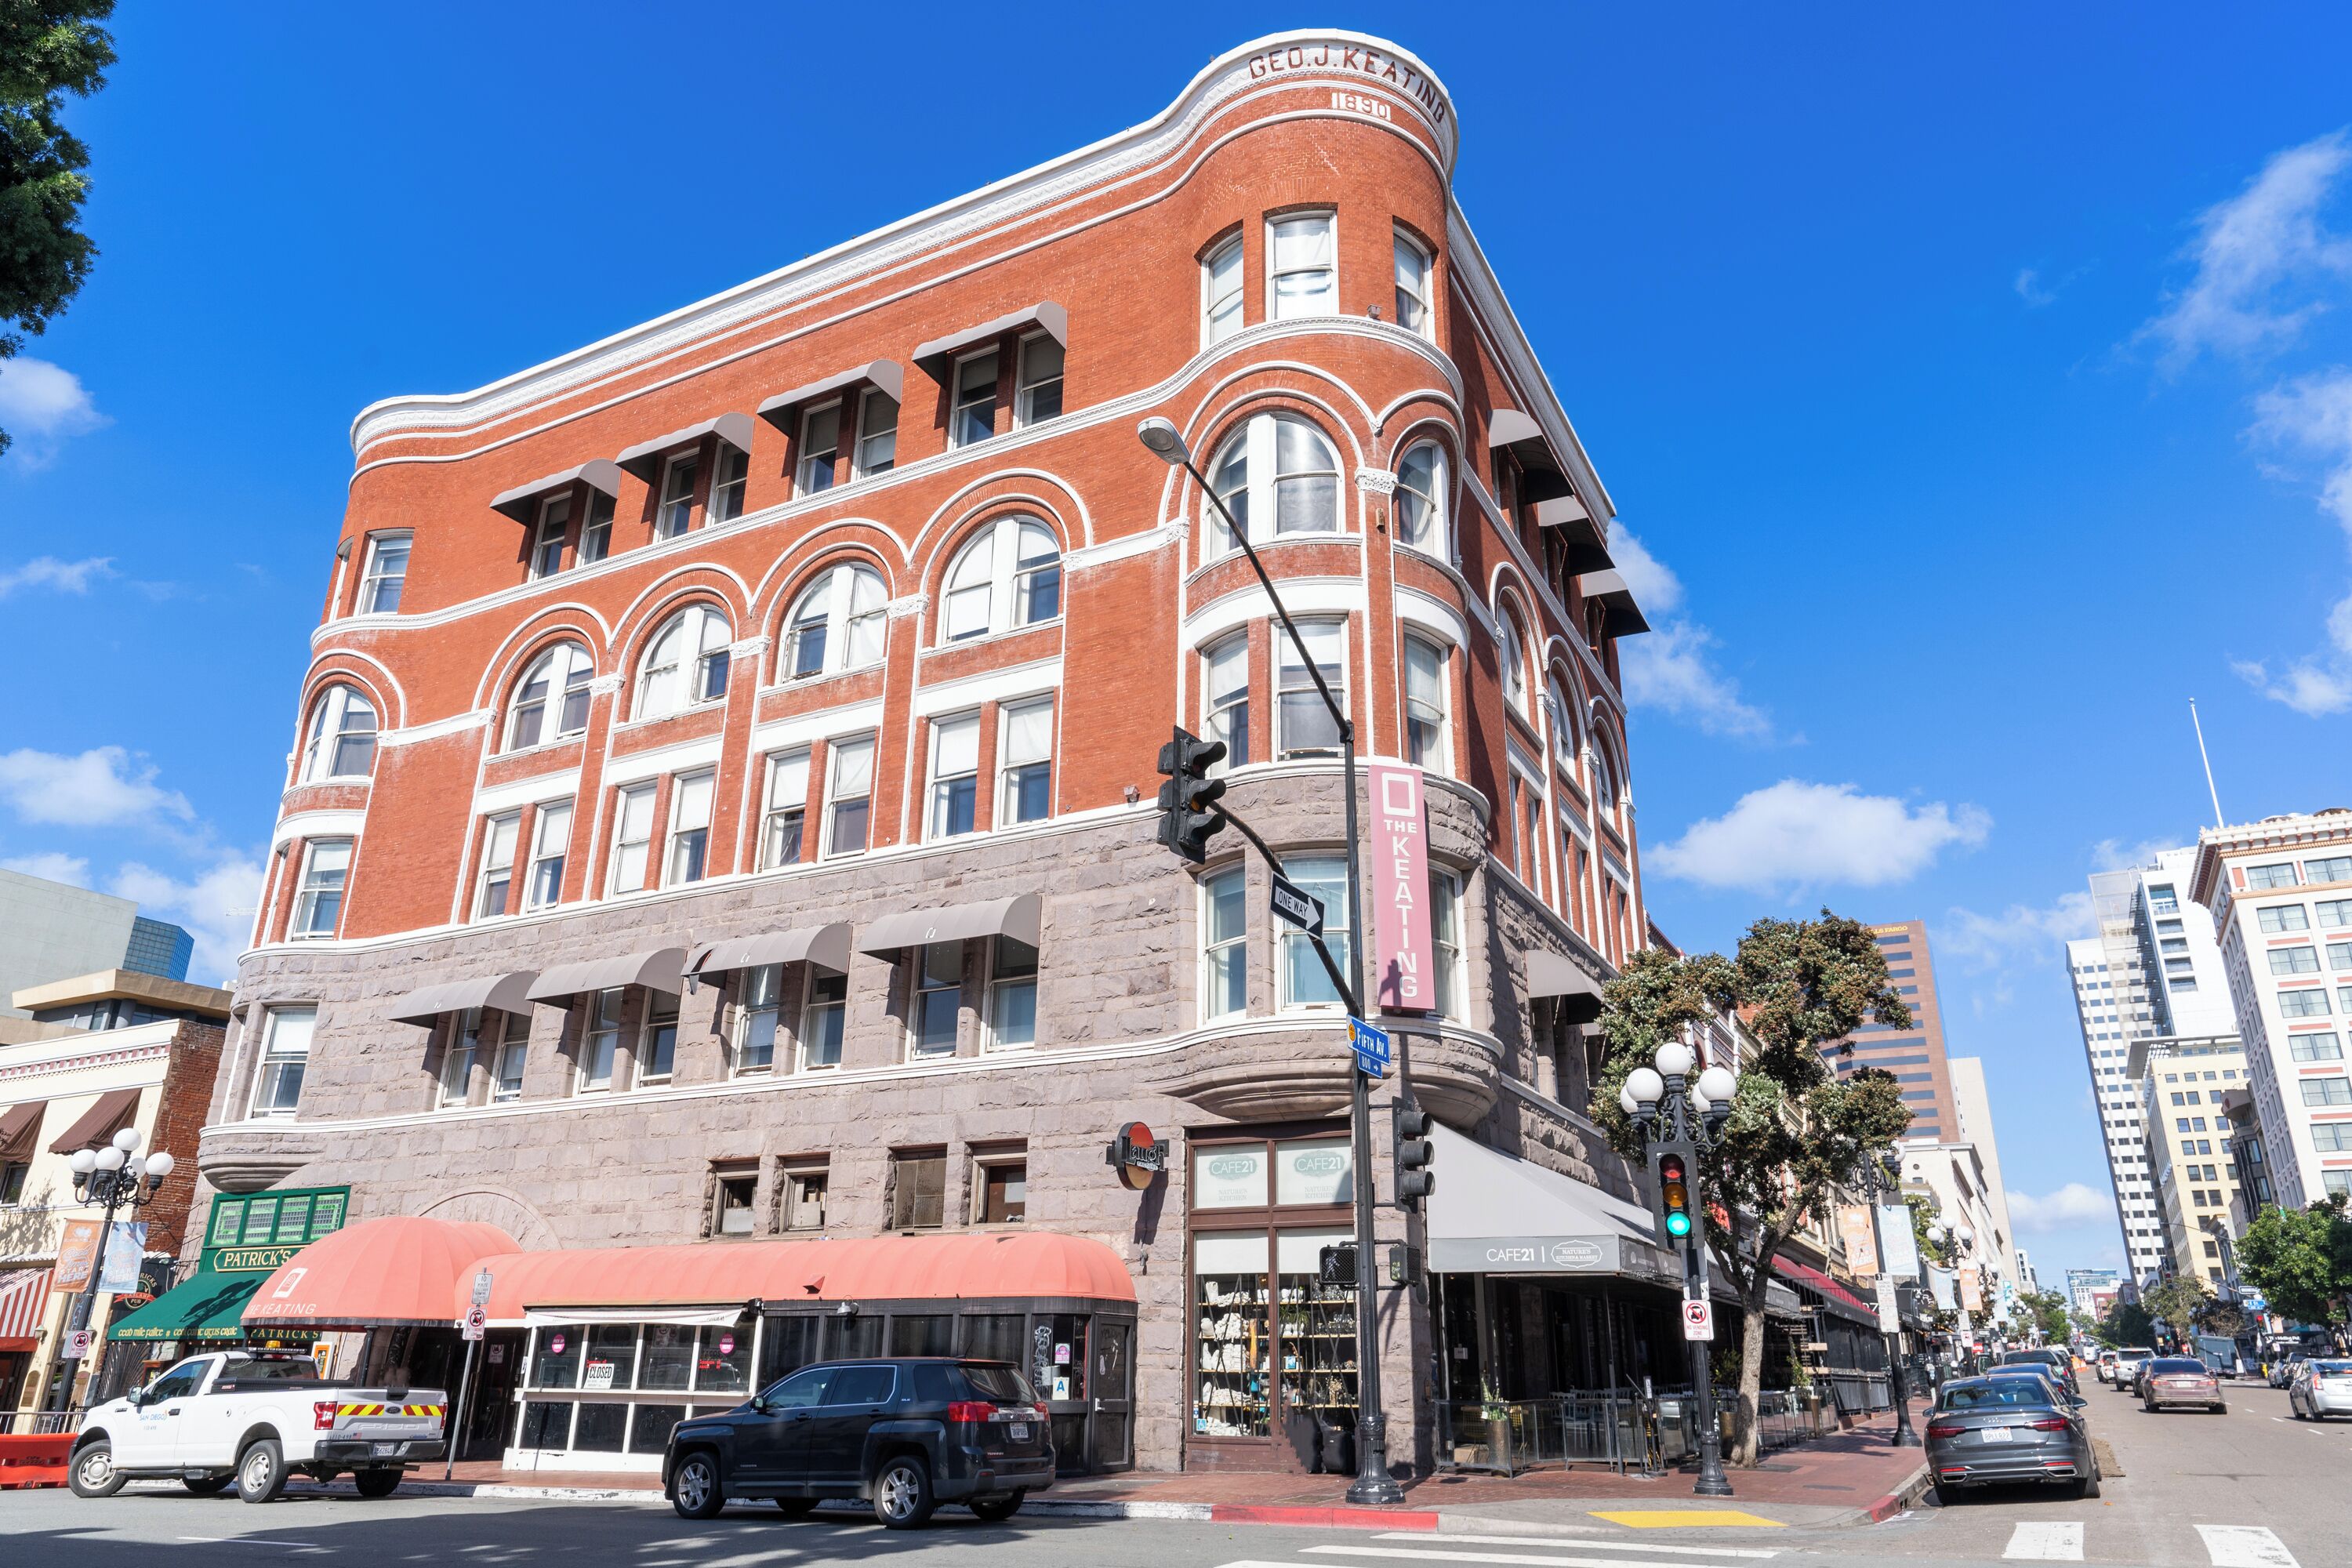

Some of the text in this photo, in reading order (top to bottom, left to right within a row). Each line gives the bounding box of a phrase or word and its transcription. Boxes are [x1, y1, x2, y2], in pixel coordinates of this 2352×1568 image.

[1335, 91, 1388, 119] 1890
[1383, 818, 1417, 833] THE
[1279, 891, 1308, 917] ONE WAY
[1392, 836, 1417, 998] KEATING
[1361, 1055, 1371, 1070] 800
[1211, 1160, 1254, 1174] CAFE21
[1296, 1156, 1341, 1171] CAFE21
[223, 1248, 292, 1267] PATRICK'S
[1486, 1248, 1535, 1262] CAFE21
[140, 1272, 158, 1287] RICKS
[260, 1303, 317, 1315] KEATING
[589, 1367, 612, 1379] CLOSED
[1056, 1380, 1065, 1392] A
